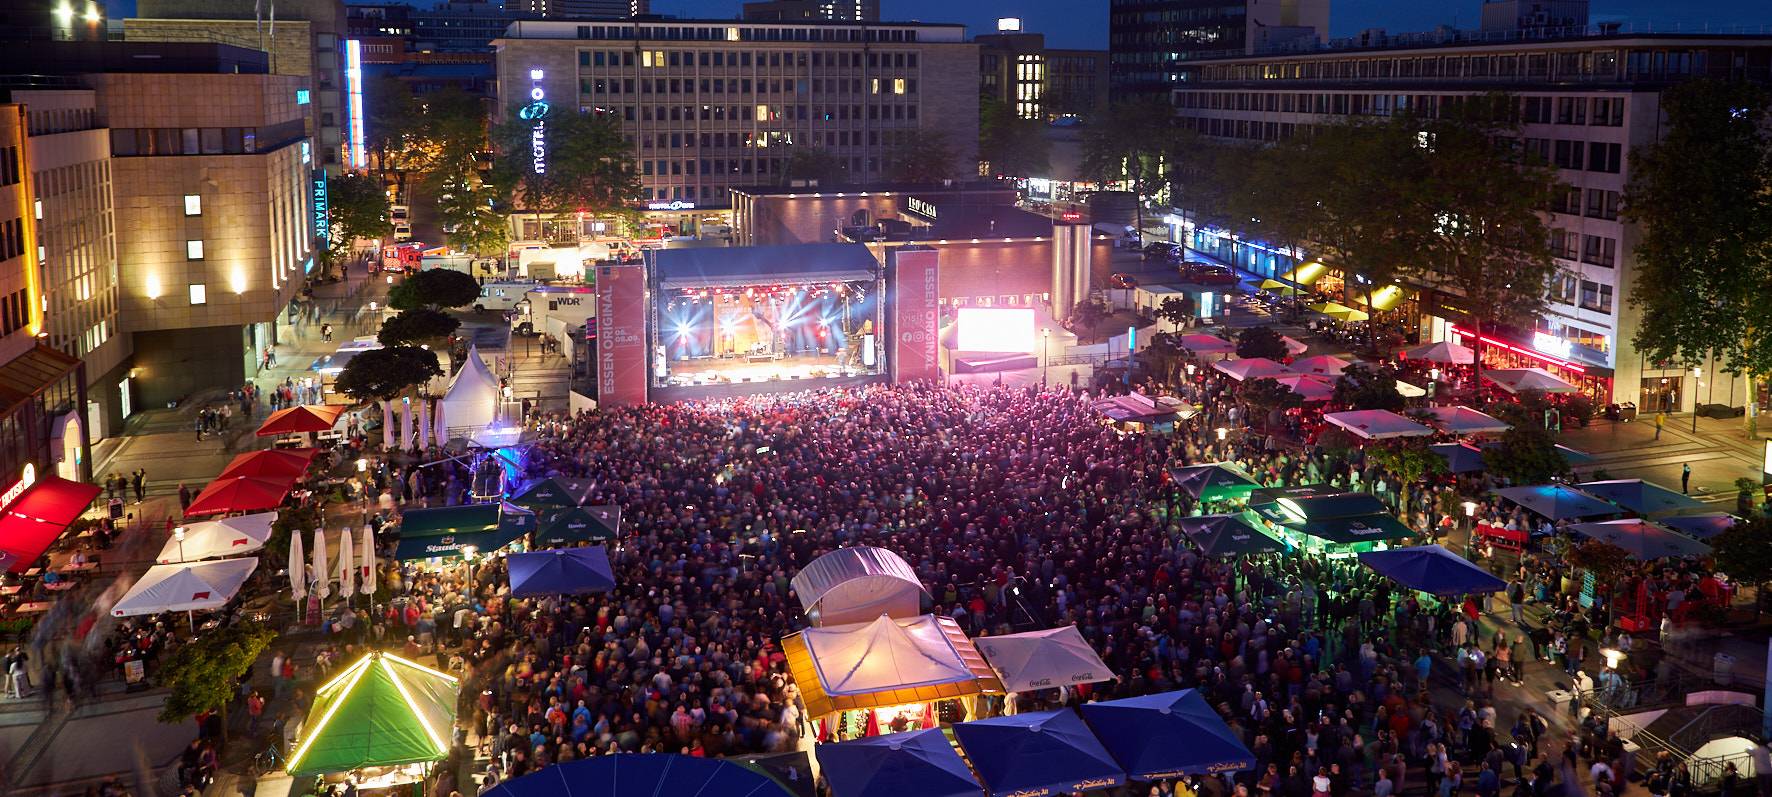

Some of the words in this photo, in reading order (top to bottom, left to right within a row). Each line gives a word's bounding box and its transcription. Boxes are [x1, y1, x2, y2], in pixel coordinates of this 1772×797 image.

[314, 180, 326, 237] PRIMARK
[921, 201, 937, 218] CASA
[556, 297, 580, 306] WDR
[925, 267, 935, 308] ESSEN
[602, 285, 613, 350] ORIGINAL
[925, 311, 935, 371] ORIGINAL
[603, 352, 614, 394] ESSEN
[1, 479, 24, 509] HOUSE
